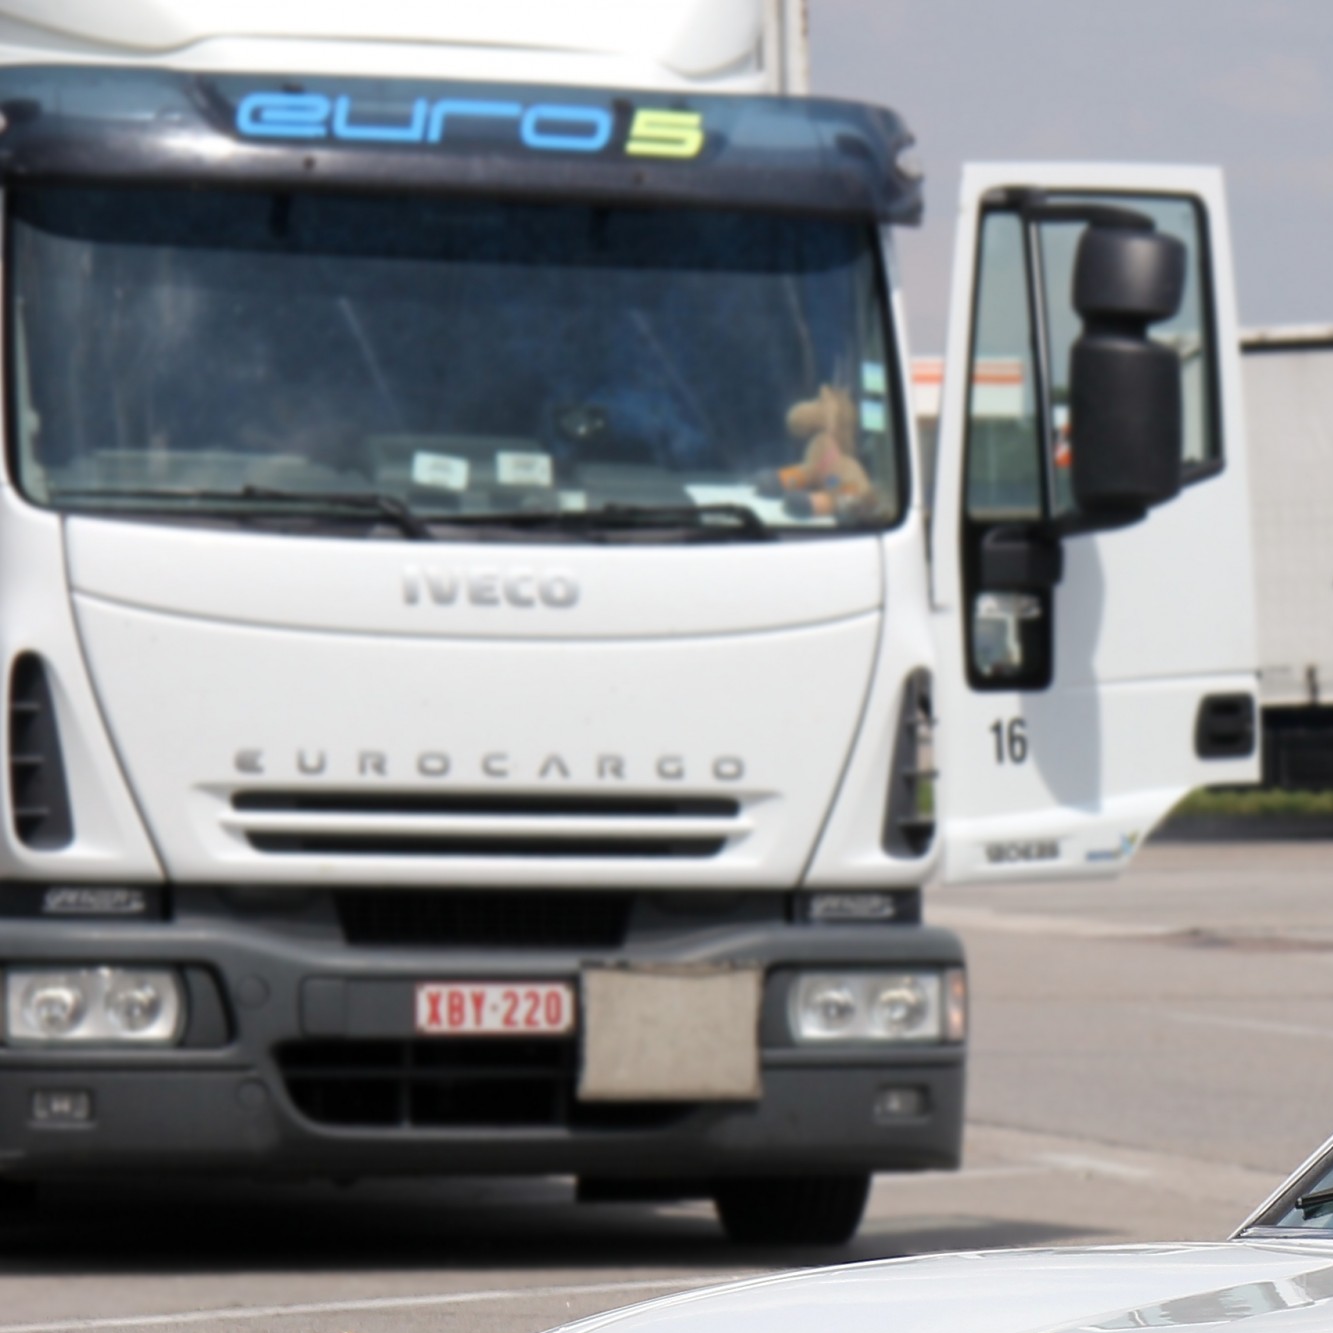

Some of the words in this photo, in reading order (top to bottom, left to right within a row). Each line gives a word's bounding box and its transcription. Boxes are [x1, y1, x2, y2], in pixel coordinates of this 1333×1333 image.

[236, 91, 611, 152] euro
[624, 108, 704, 159] 5
[402, 565, 580, 608] IVECO
[989, 717, 1028, 764] 16
[234, 748, 746, 781] EUROCARGO
